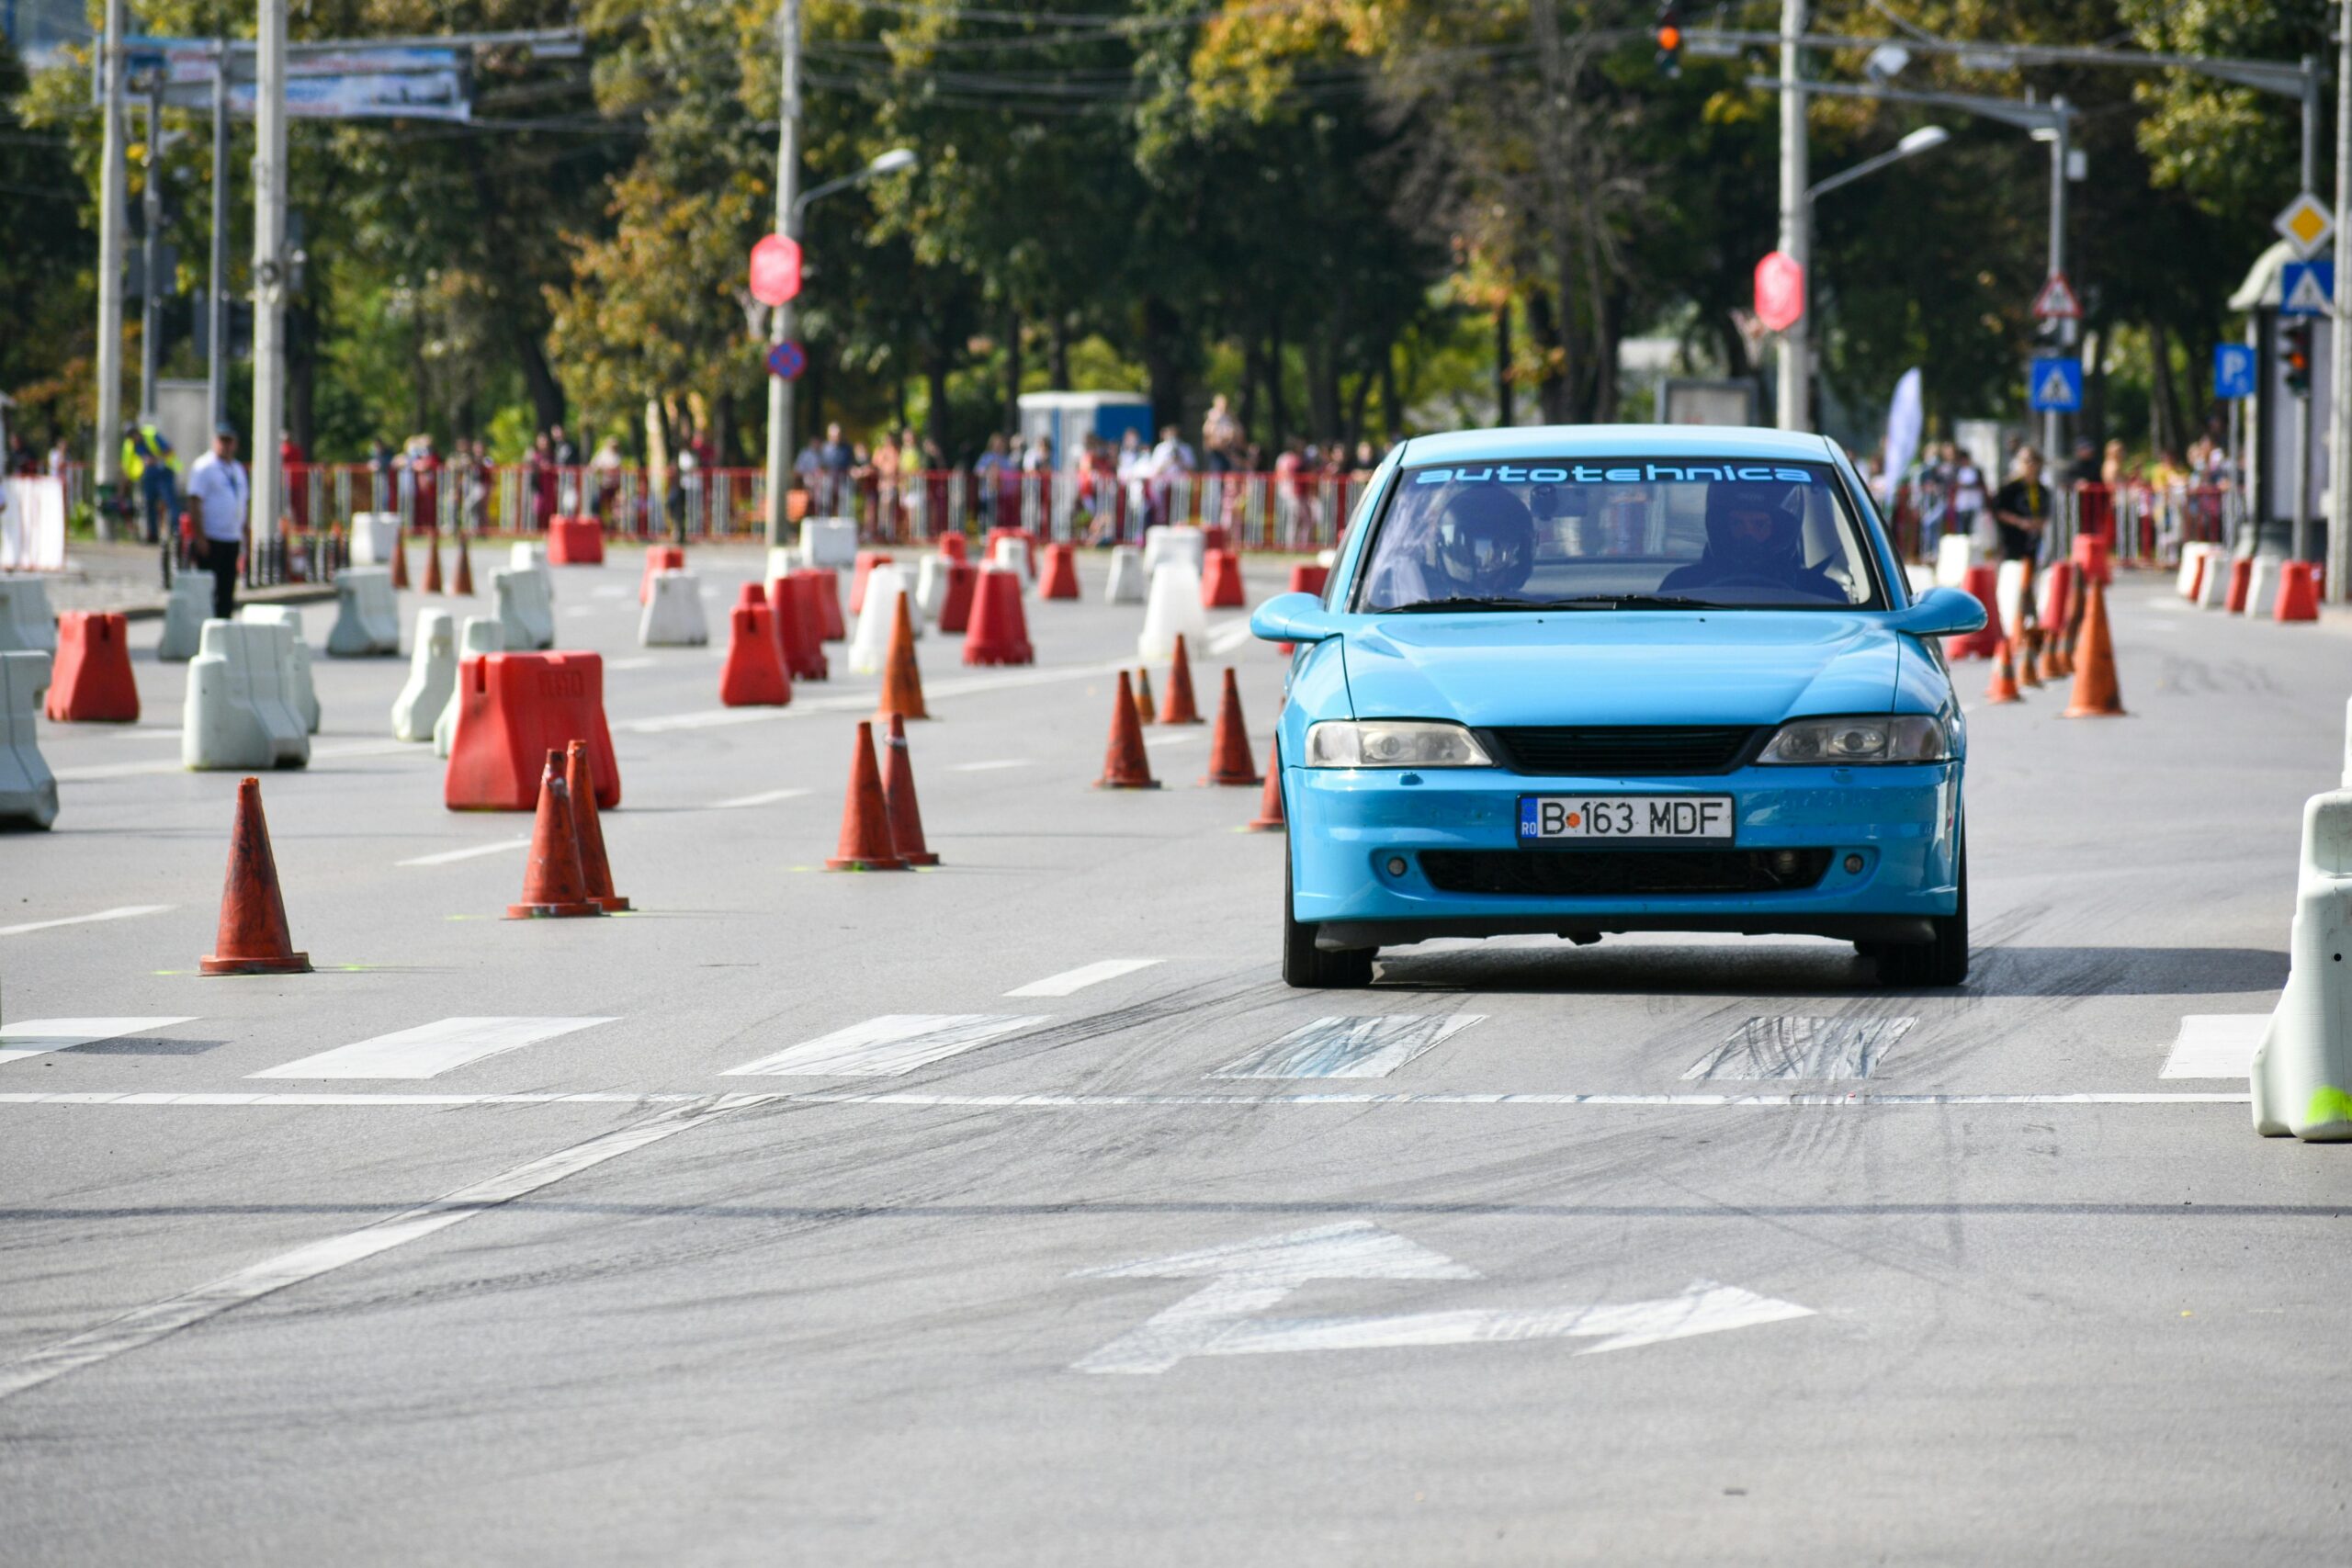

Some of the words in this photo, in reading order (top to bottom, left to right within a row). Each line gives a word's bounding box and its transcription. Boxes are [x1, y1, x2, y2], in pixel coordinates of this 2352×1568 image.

[2222, 350, 2247, 384] P
[1416, 465, 1812, 484] autotehnica
[1521, 822, 1537, 836] RO
[1542, 802, 1566, 835] B
[1580, 802, 1634, 835] 163
[1649, 802, 1724, 835] MDF
